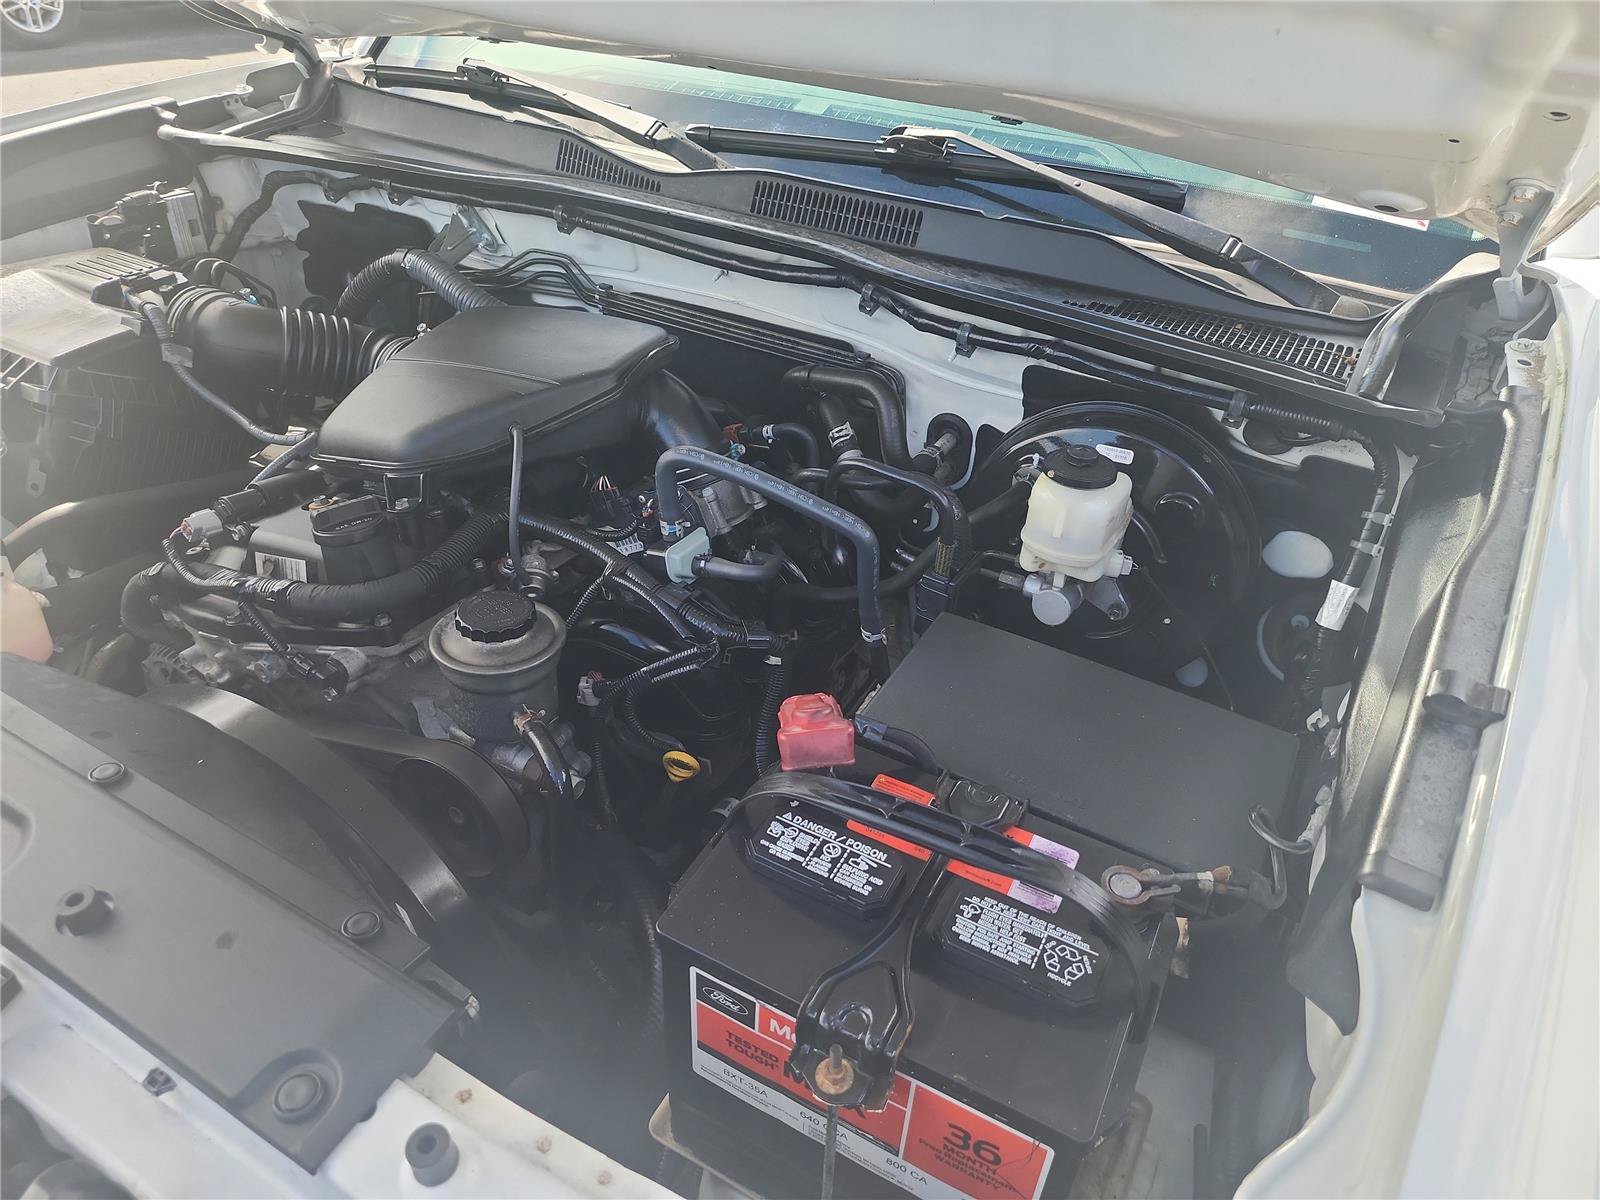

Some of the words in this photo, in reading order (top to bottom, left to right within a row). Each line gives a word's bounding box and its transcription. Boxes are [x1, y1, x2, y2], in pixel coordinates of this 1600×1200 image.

[793, 815, 838, 840] DANGER
[846, 839, 888, 861] POISON
[819, 853, 831, 862] NO
[841, 862, 869, 879] SULFURIC
[868, 874, 883, 886] ACID
[979, 913, 993, 923] WITH
[1011, 926, 1023, 935] GET
[980, 899, 992, 908] NOT
[1074, 939, 1091, 949] LEVEL
[982, 908, 999, 919] FLUSH
[998, 915, 1012, 924] EYES
[997, 902, 1010, 910] OUT
[1017, 910, 1029, 919] THE
[1028, 915, 1047, 926] REACH
[1055, 926, 1082, 940] CHILDREN
[977, 918, 999, 931] MEDICAL
[998, 927, 1013, 937] HELP
[1012, 933, 1026, 943] FAST
[1047, 972, 1072, 987] RECYCLE
[709, 990, 741, 1012] Ford
[726, 1030, 779, 1063] TESTED
[723, 1068, 768, 1098] BXT-35A
[799, 1111, 820, 1127] 640
[943, 1122, 1002, 1166] 36
[885, 1157, 907, 1173] 800
[910, 1169, 928, 1185] CA
[934, 1155, 1001, 1190] WARRANTY
[943, 1144, 998, 1175] MONTH
